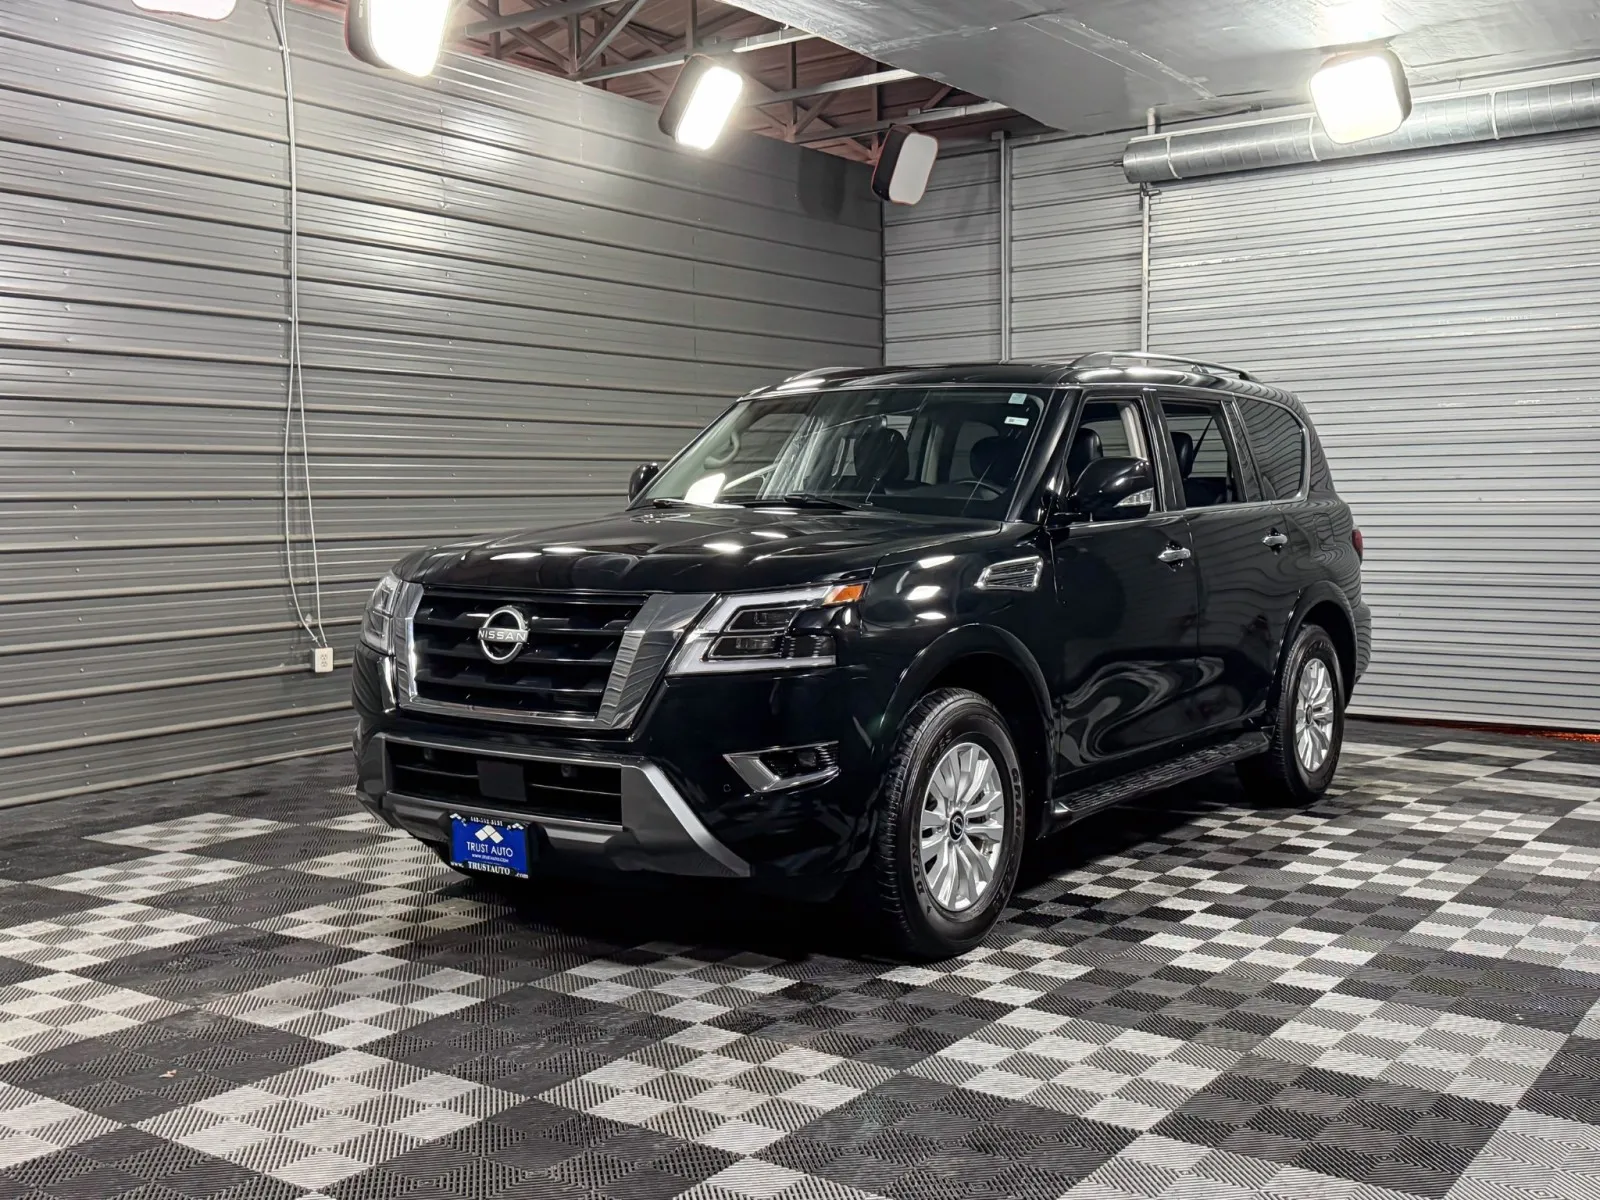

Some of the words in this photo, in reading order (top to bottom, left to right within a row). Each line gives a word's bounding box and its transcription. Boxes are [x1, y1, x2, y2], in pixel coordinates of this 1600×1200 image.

[478, 630, 527, 641] NISSAN
[466, 841, 489, 854] TRUST
[490, 845, 514, 858] AUTO
[467, 860, 511, 876] TRUSTAUTO
